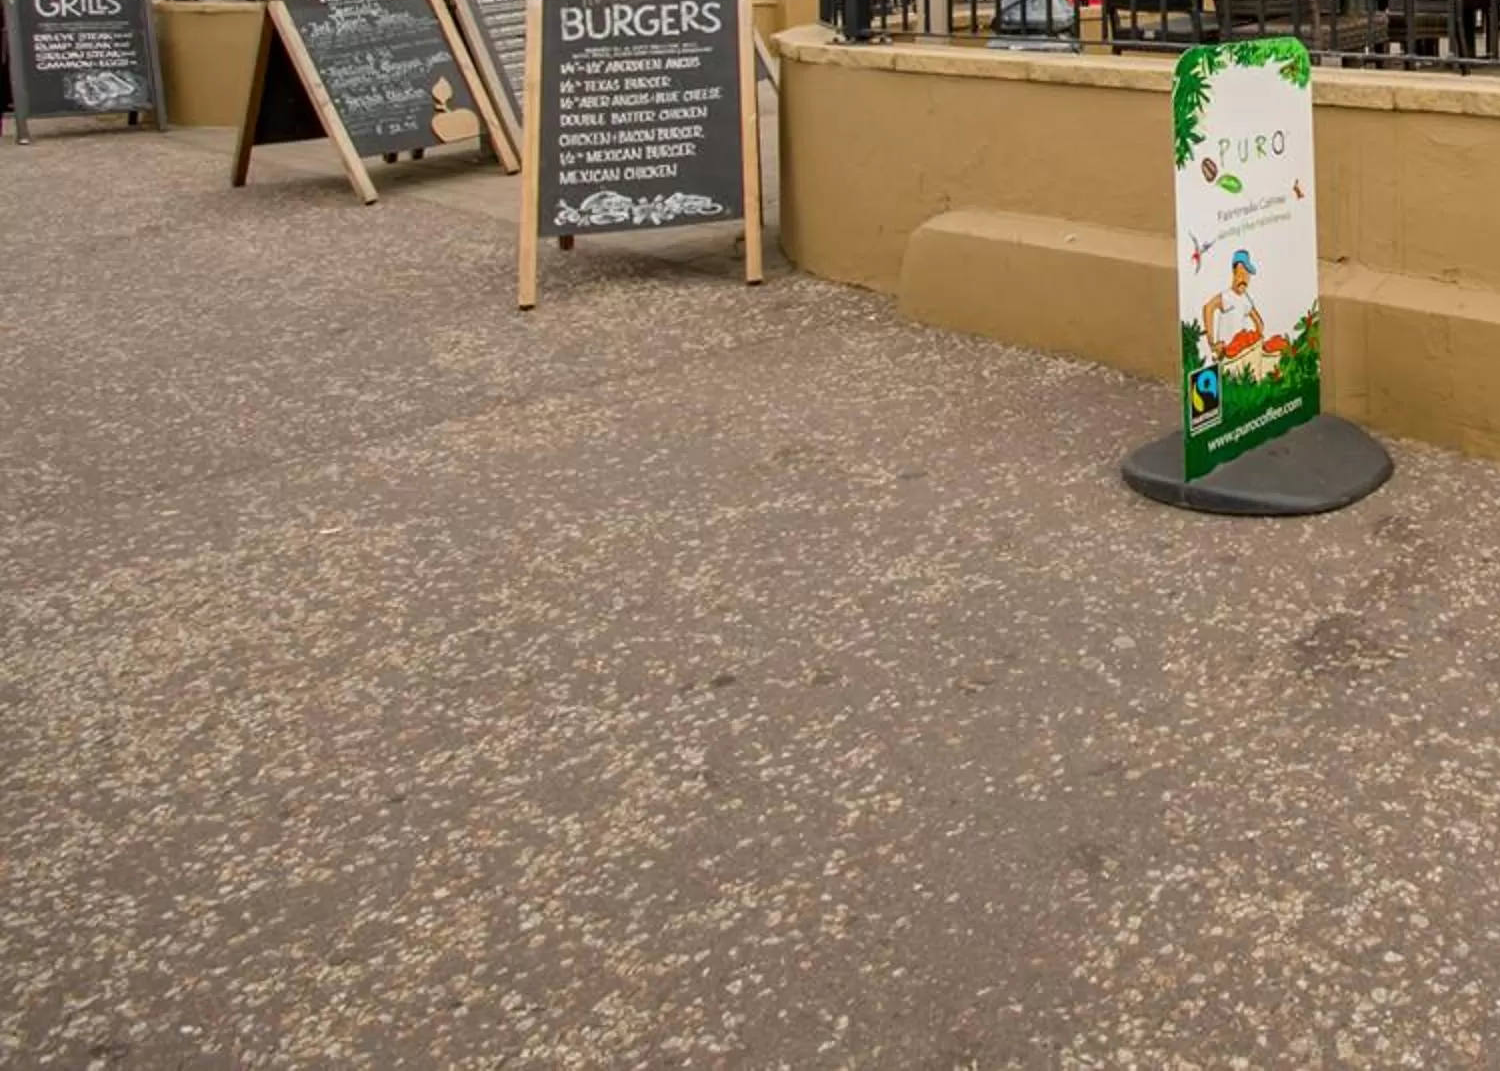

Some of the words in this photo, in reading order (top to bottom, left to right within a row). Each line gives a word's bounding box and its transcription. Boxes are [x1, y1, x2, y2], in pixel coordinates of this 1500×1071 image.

[560, 0, 722, 41] BURGERS
[584, 78, 621, 92] TEXAS
[585, 147, 642, 163] MEXICAN
[1218, 130, 1285, 168] PURO
[559, 168, 621, 185] MEXICAN
[624, 163, 678, 181] CHICKEN
